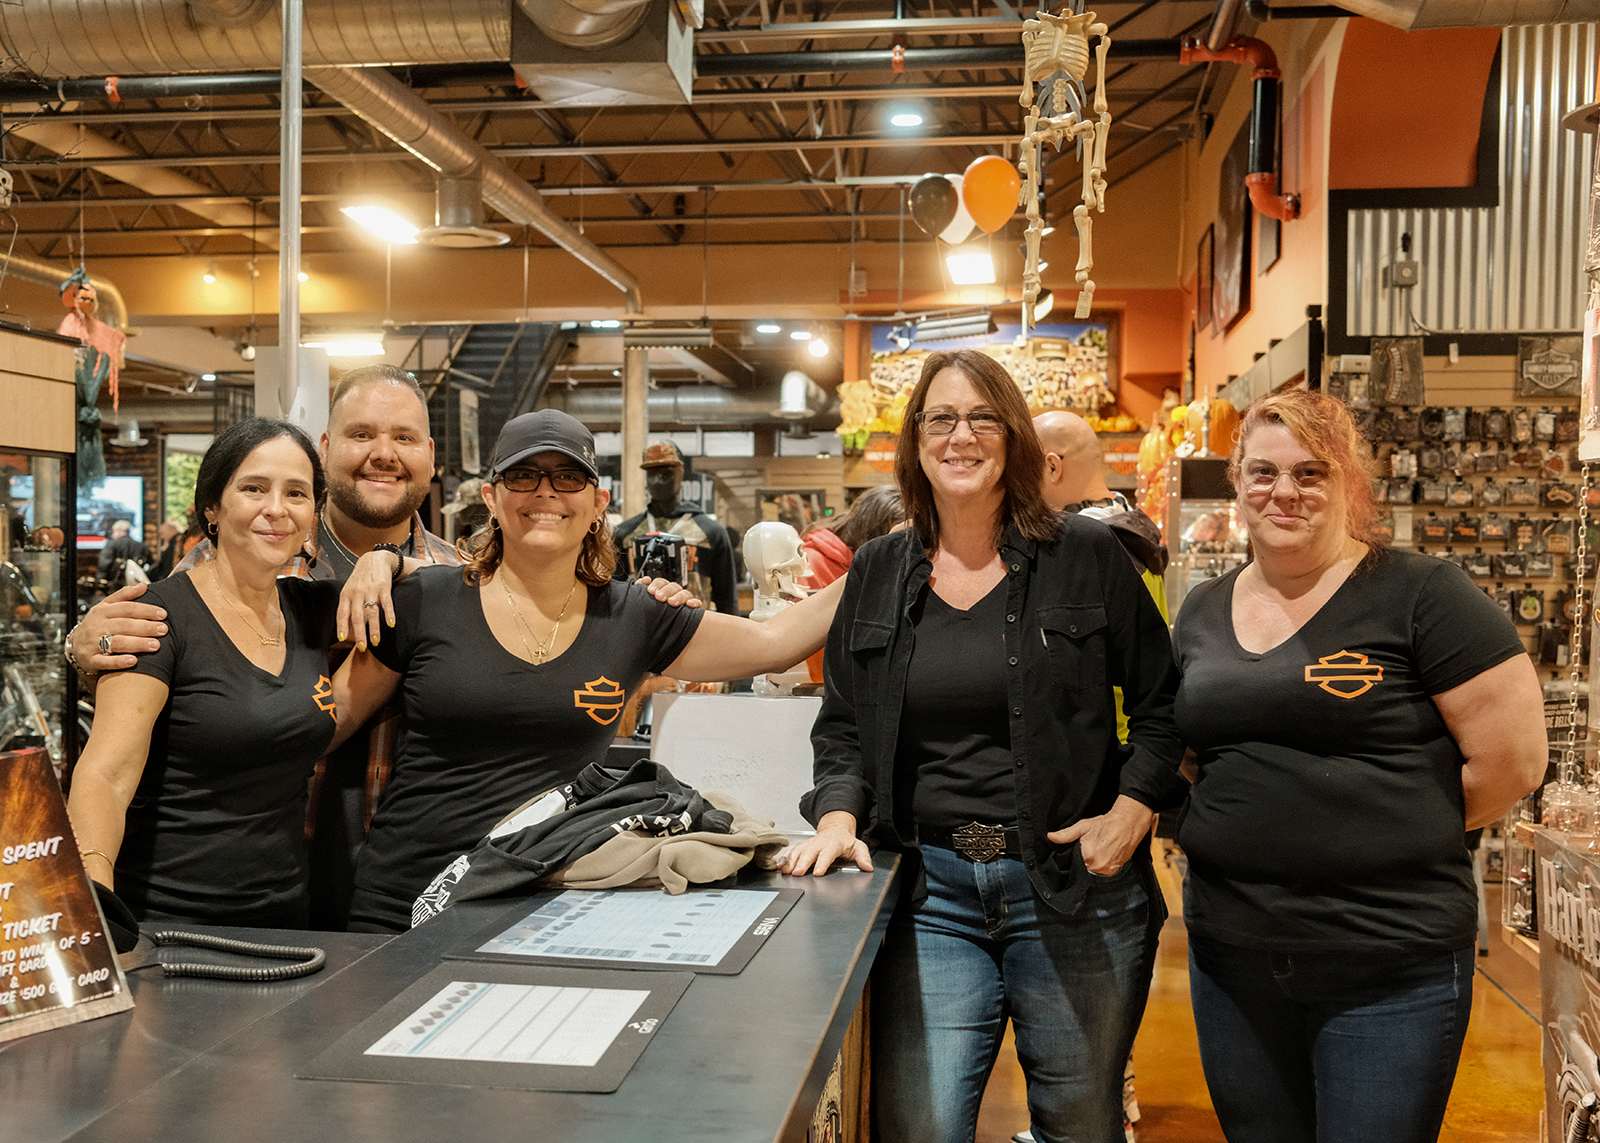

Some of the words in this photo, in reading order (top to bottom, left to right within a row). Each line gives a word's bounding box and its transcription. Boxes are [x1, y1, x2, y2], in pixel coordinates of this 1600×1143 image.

[2, 836, 64, 865] SPENT
[2, 912, 63, 941] TICKET
[1, 949, 16, 963] TO
[60, 935, 76, 951] OF
[80, 931, 91, 946] 5
[9, 976, 20, 989] &
[78, 967, 109, 987] CARD
